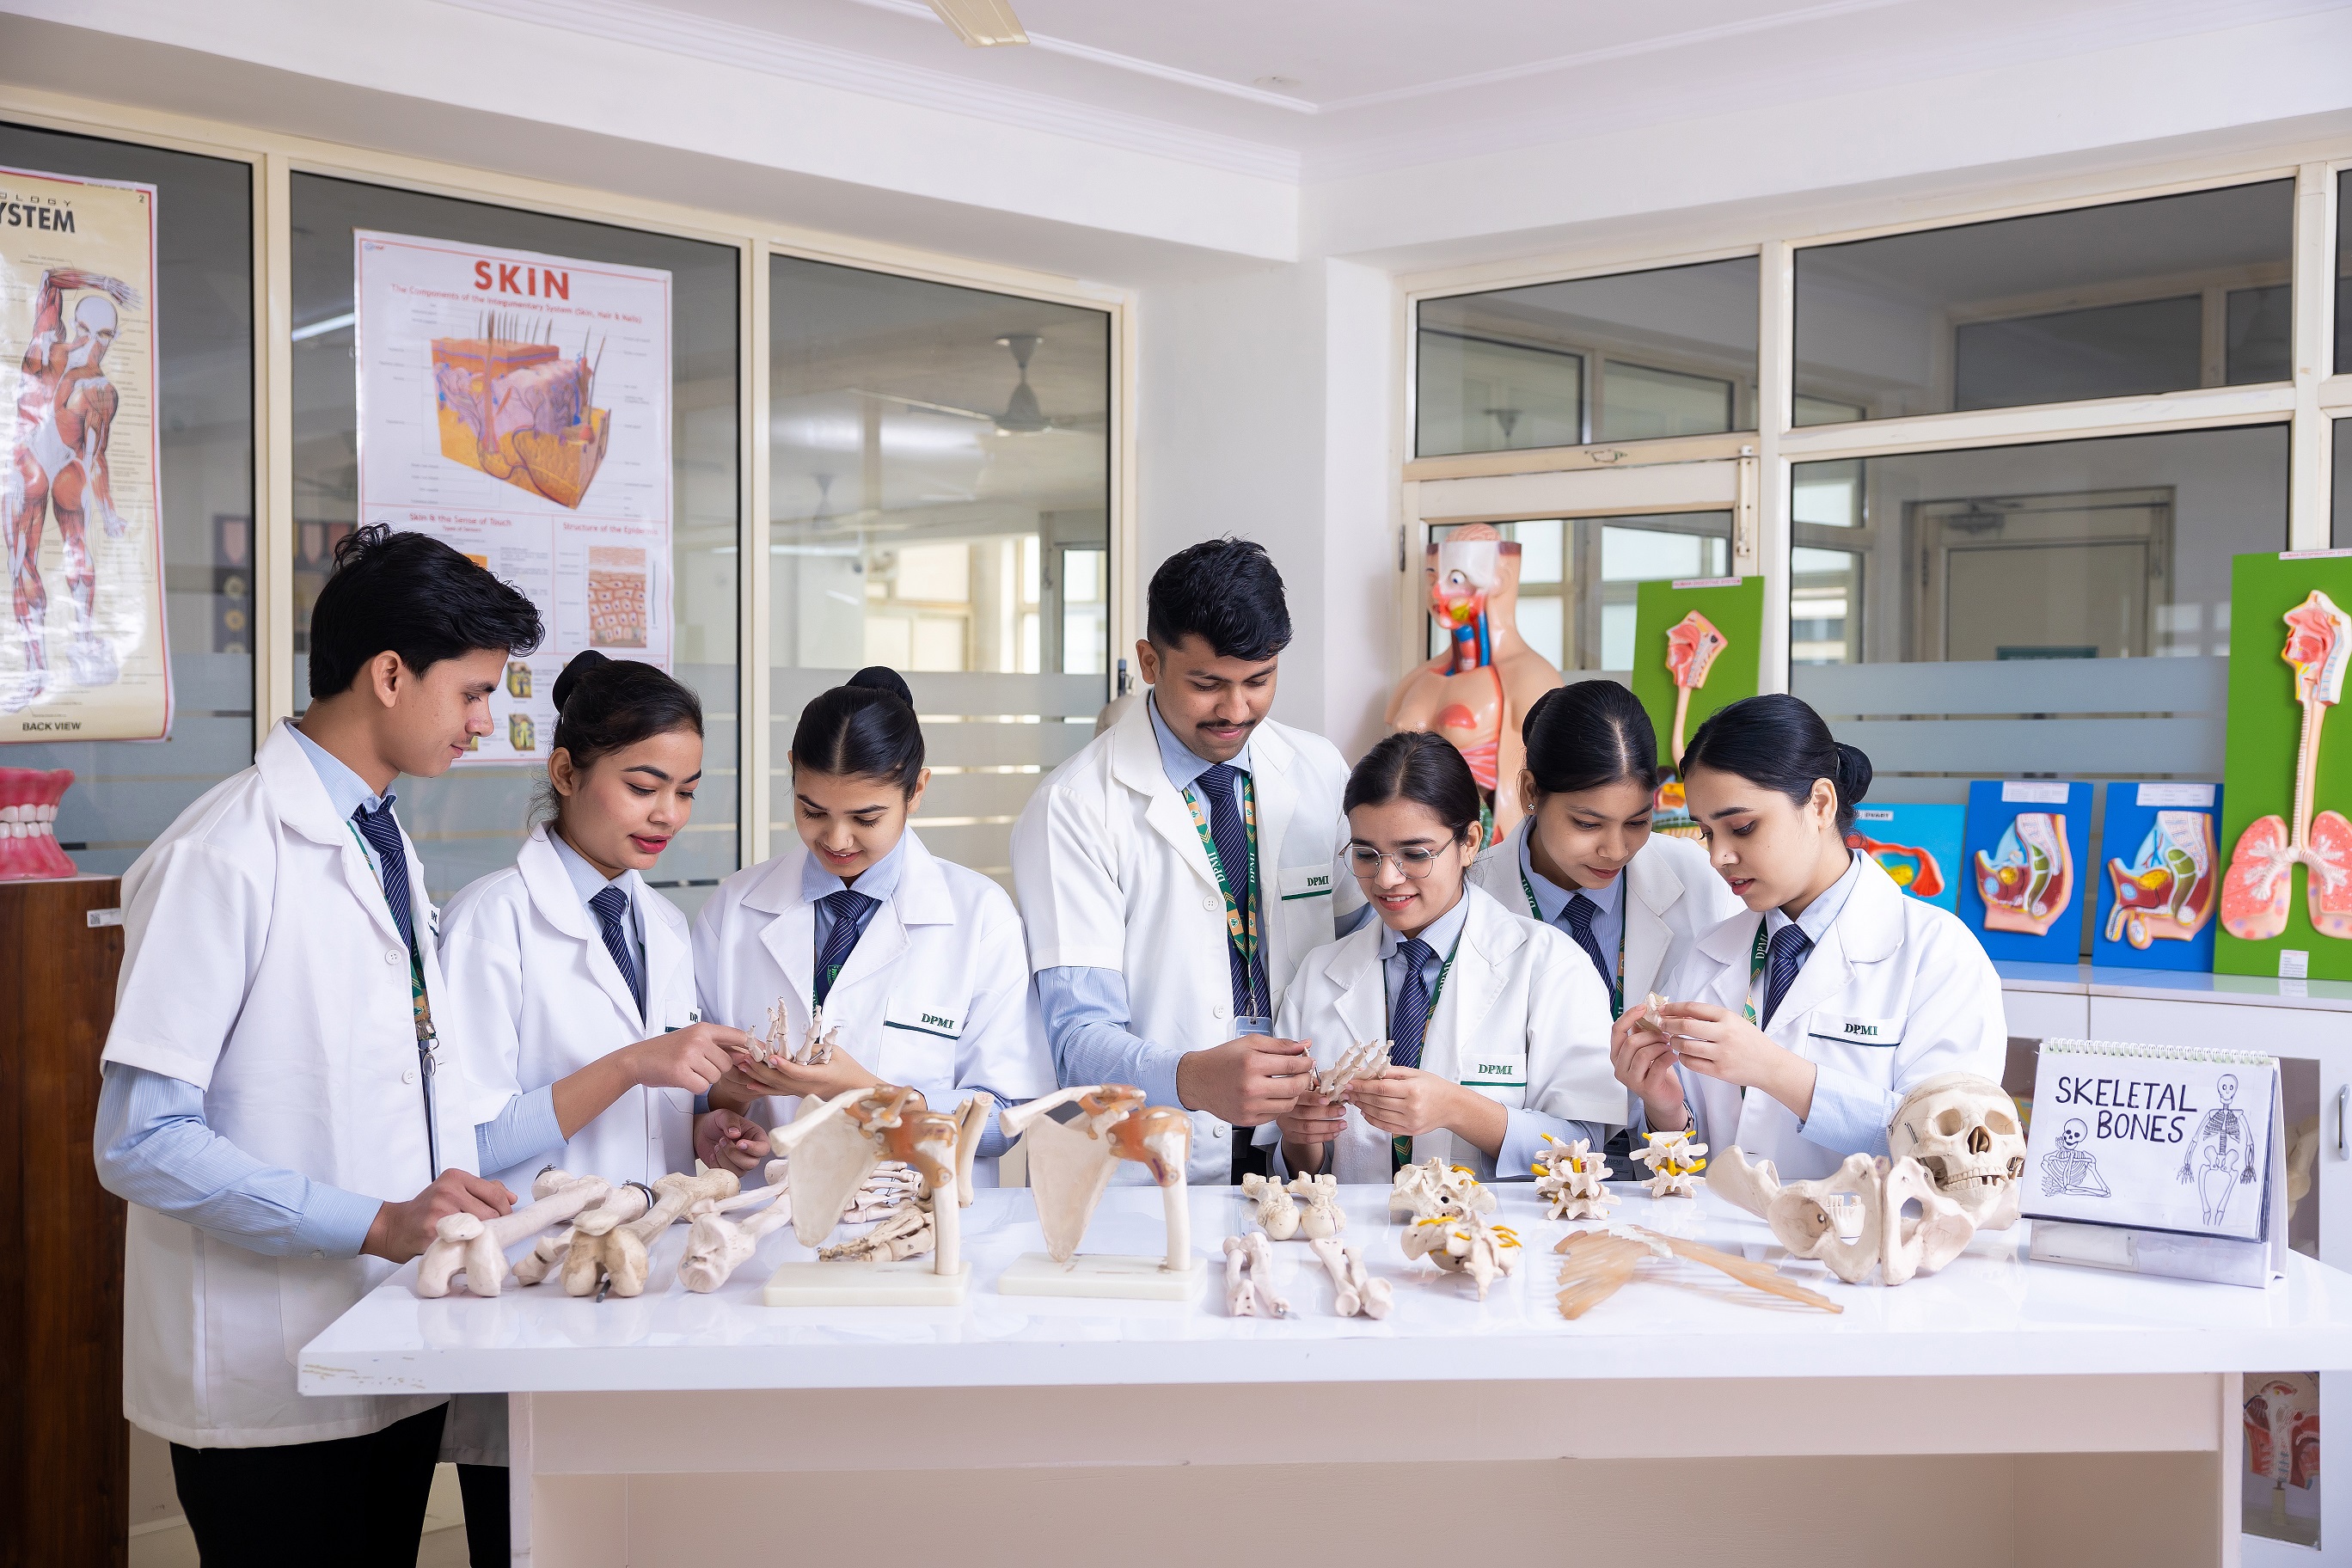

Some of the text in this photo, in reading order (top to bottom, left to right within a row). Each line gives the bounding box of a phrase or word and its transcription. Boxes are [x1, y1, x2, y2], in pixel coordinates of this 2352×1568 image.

[138, 194, 144, 204] 2
[475, 260, 569, 300] SKIN
[22, 722, 52, 731] BACK
[1208, 851, 1226, 883] DPMI
[1307, 875, 1330, 886] DPMI
[1755, 934, 1768, 959] DPMI
[921, 1013, 955, 1030] DPMI
[1844, 1023, 1878, 1036] DPMI
[1479, 1063, 1513, 1075] DPMI
[2055, 1076, 2198, 1112] SKELETAL
[2097, 1110, 2186, 1143] BONES
